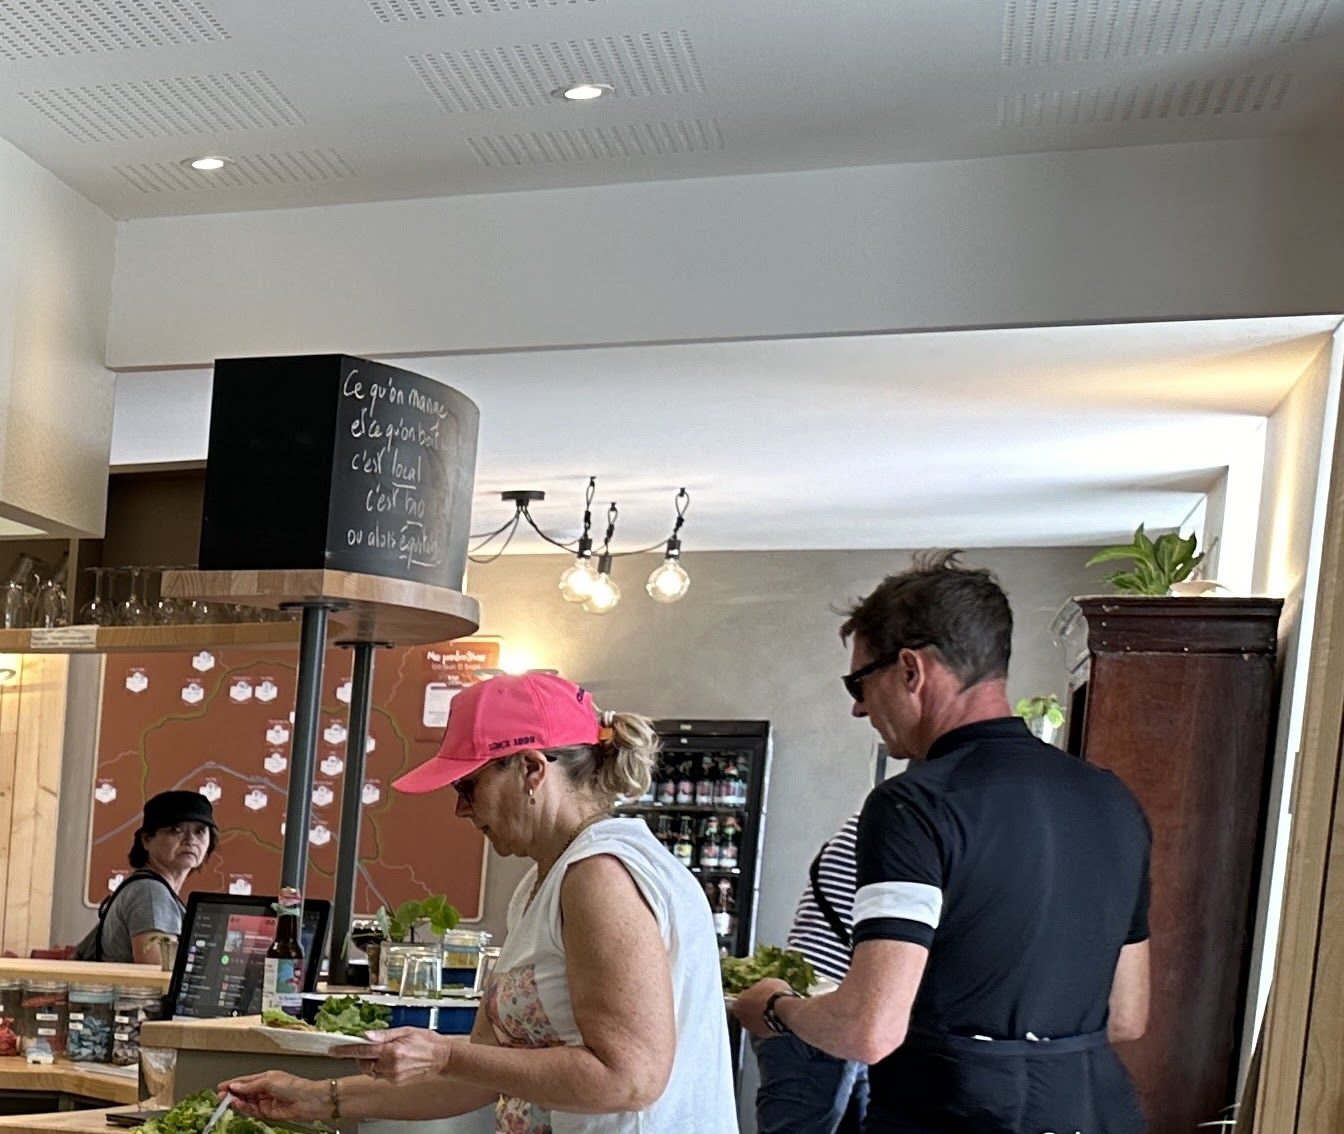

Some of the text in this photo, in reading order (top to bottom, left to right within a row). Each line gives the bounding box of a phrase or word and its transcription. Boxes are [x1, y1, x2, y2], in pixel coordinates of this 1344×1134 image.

[343, 370, 364, 399] Ce
[370, 377, 404, 418] qu'on
[351, 407, 367, 437] et
[385, 418, 416, 453] qu'on
[352, 447, 421, 481] c'est local
[366, 483, 399, 512] c'est
[347, 529, 363, 545] ou
